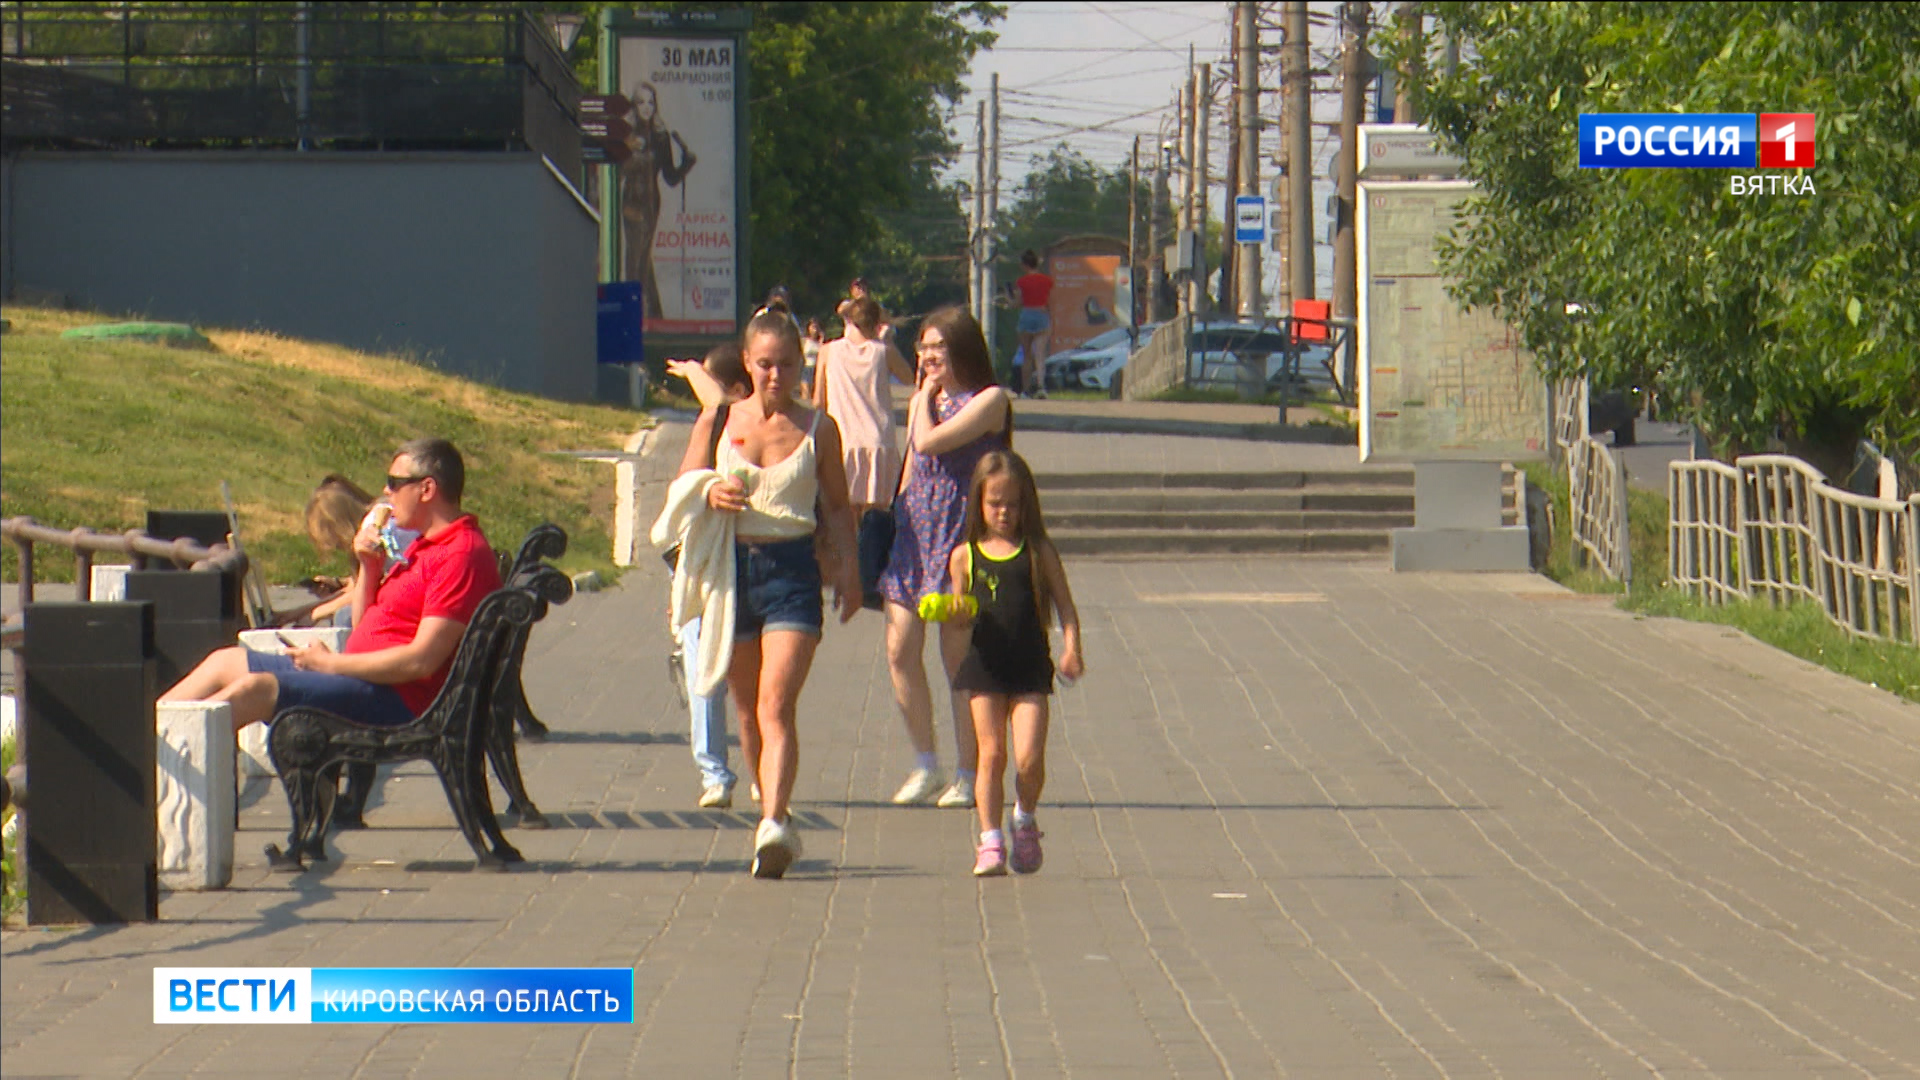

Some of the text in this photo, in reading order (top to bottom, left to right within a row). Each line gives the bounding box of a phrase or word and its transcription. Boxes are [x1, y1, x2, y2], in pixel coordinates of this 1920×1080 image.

[662, 47, 731, 67] 30 МАЯ
[651, 70, 732, 84] ФИЛАРМОНИЯ
[675, 213, 728, 224] ЛАРИСА
[655, 231, 731, 248] ДОЛИНА
